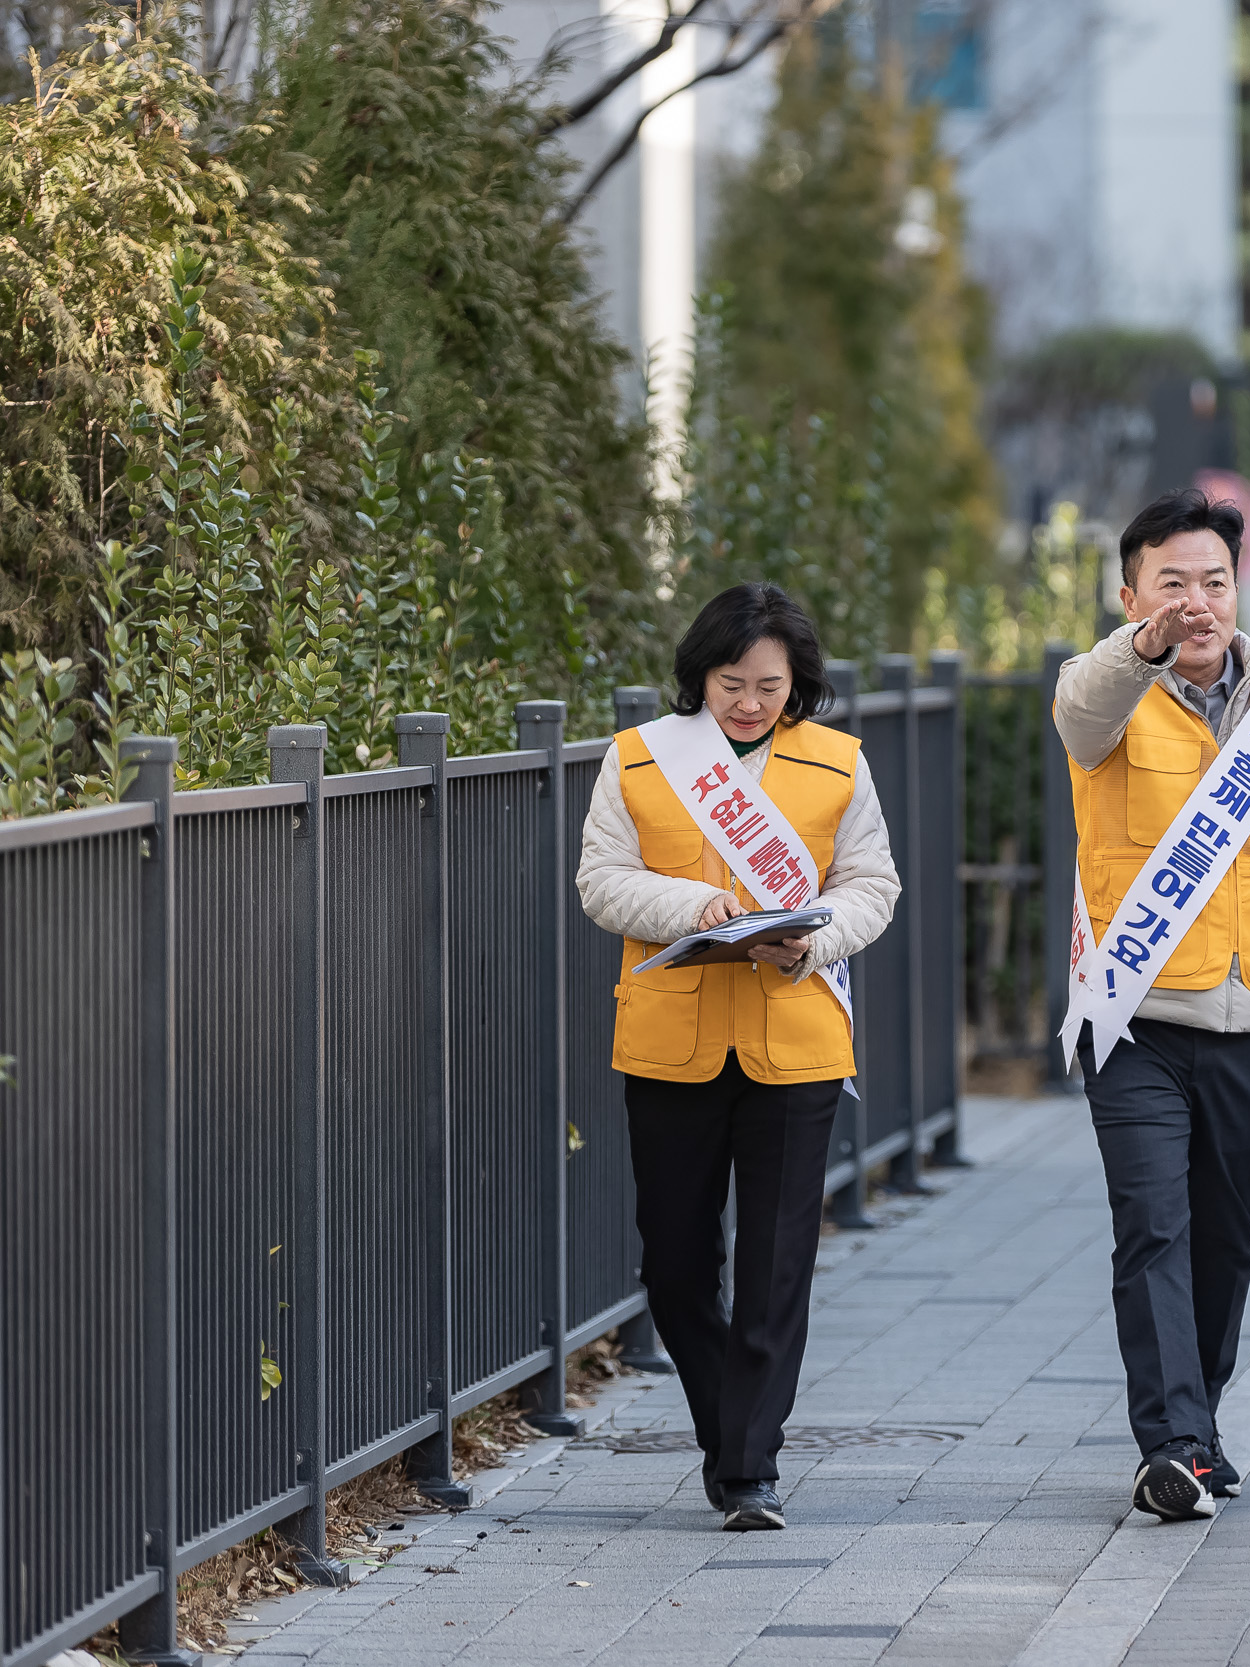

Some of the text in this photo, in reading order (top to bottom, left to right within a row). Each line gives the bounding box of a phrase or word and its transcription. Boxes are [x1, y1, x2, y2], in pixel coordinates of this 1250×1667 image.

[690, 762, 730, 804] 차
[710, 788, 770, 850] 없는
[1152, 811, 1230, 910] 만들어
